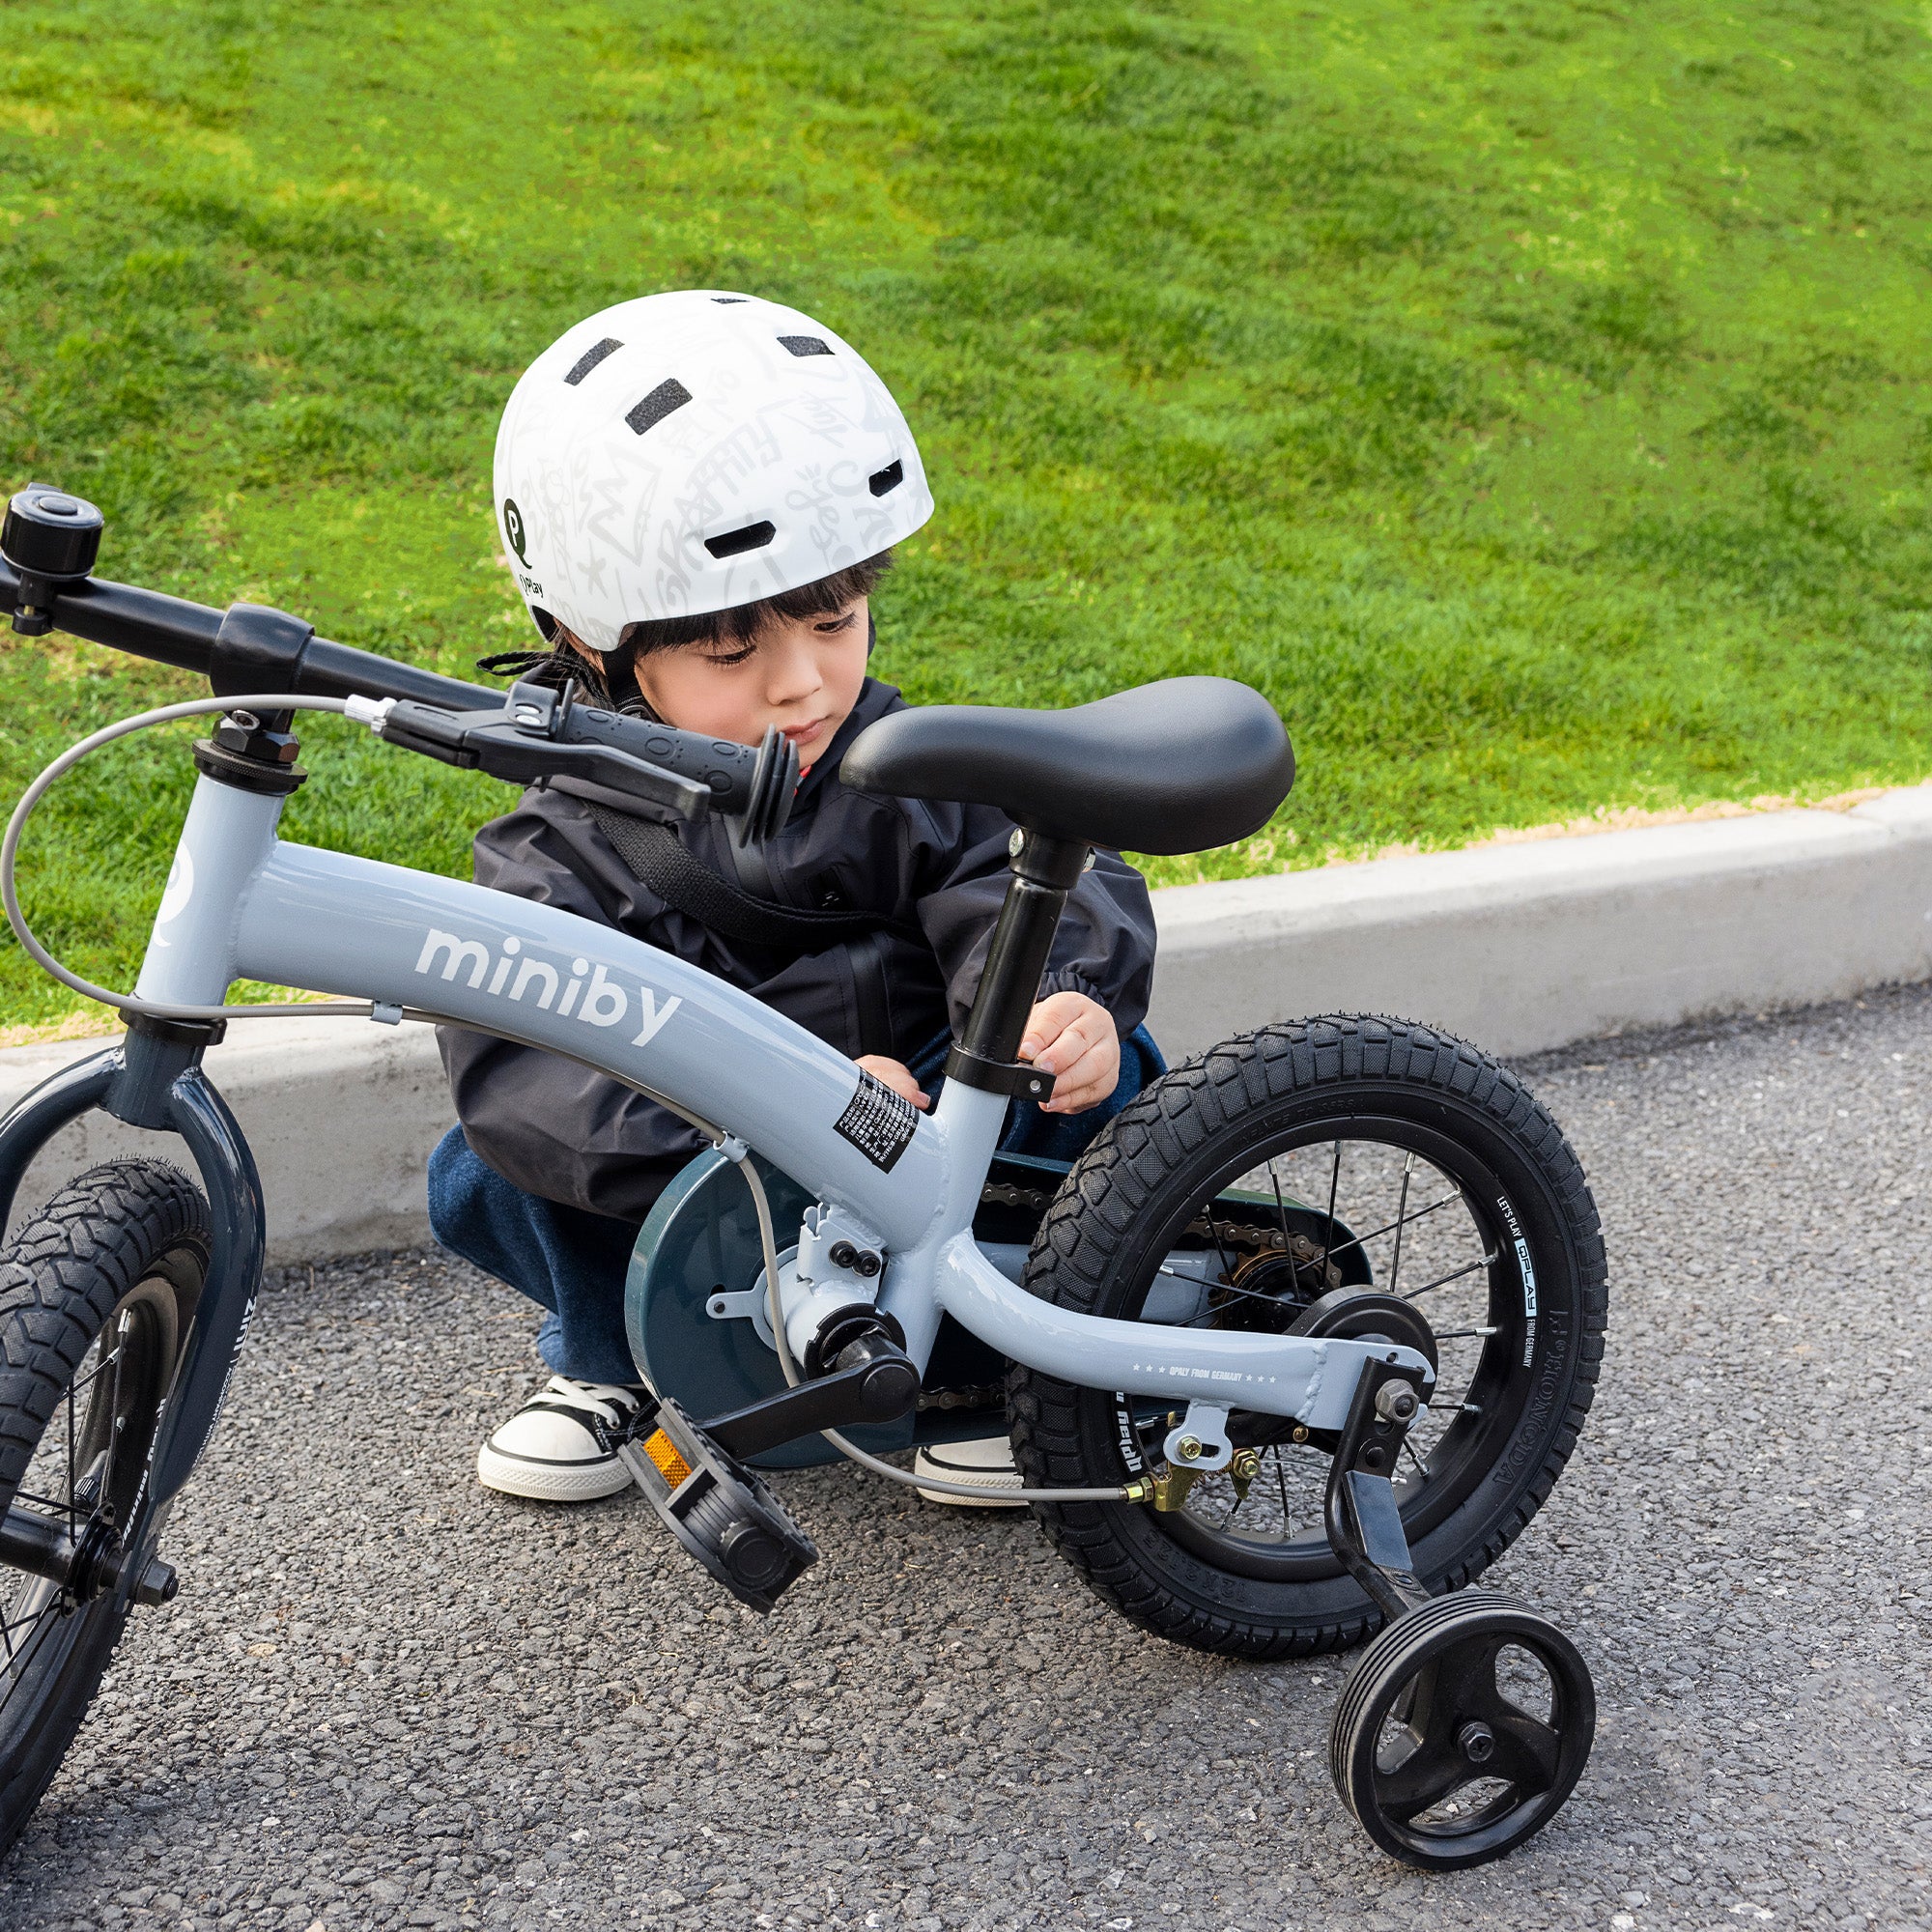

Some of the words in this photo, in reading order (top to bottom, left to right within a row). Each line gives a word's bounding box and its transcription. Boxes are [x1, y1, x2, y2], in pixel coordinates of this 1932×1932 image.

[414, 928, 683, 1047] miniby
[1497, 1196, 1513, 1217] LET'S
[1508, 1217, 1522, 1236] PLAY
[1519, 1246, 1536, 1310] QPLAY
[1526, 1320, 1536, 1336] FROM
[1522, 1337, 1534, 1368] GERMANY
[1211, 1370, 1243, 1382] GERMANY
